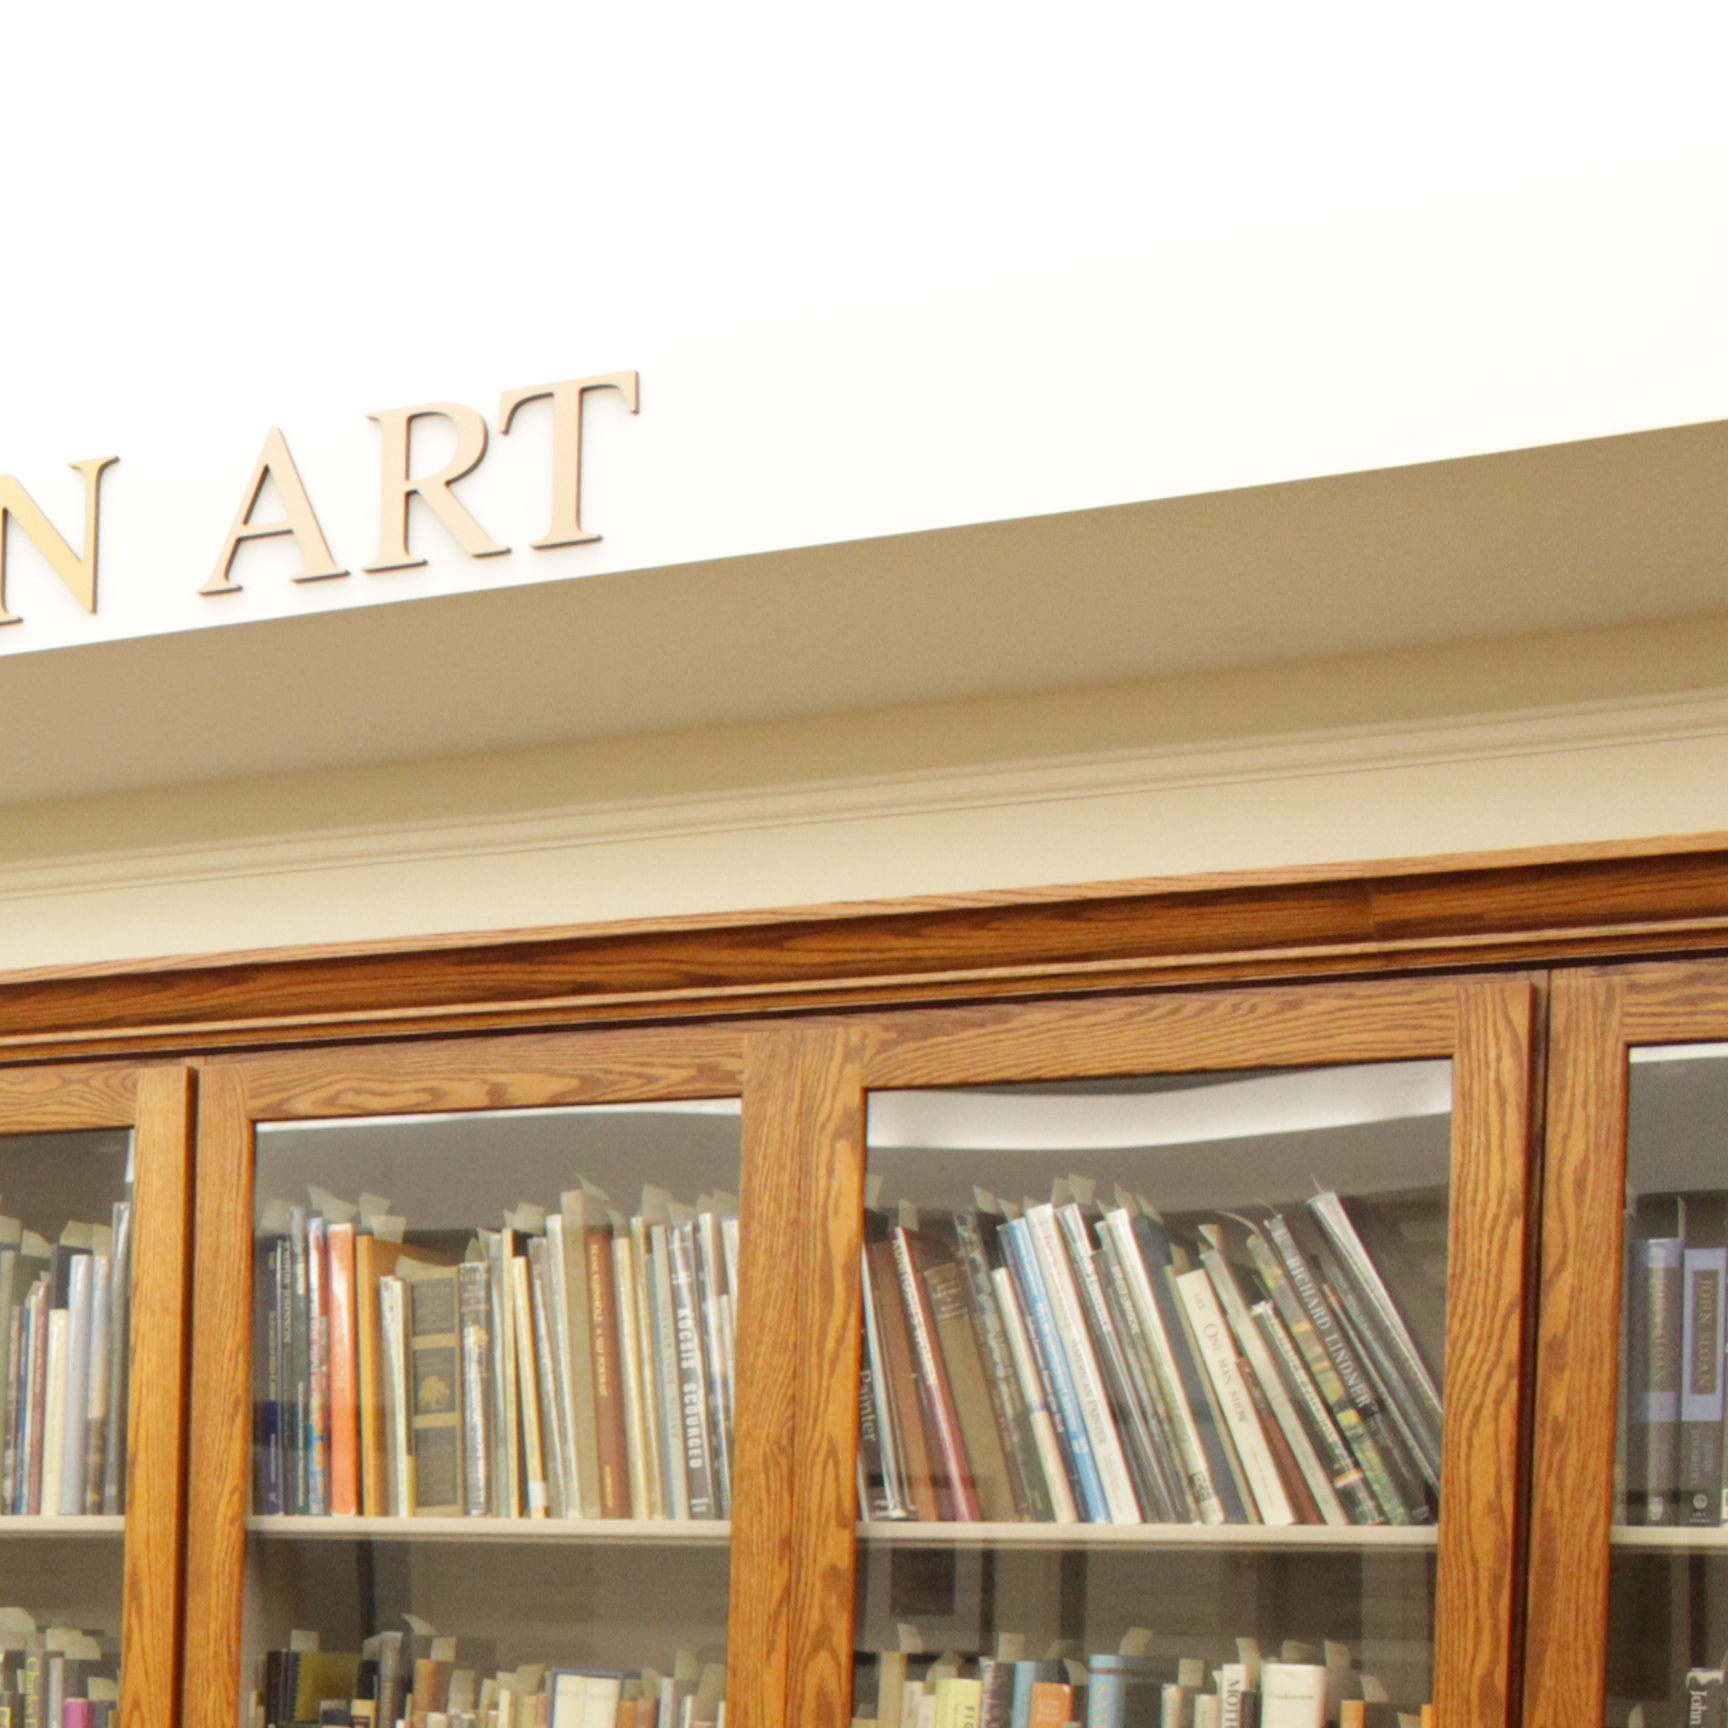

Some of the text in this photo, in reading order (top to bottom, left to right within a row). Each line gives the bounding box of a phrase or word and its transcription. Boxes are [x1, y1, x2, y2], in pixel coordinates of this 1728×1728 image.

[196, 370, 641, 602] ART
[281, 1288, 292, 1343] JOHNSON
[914, 1330, 936, 1386] WOMEN
[1285, 1257, 1371, 1409] RICHARD LINDNER
[1697, 1280, 1713, 1386] JOHN SLOAN
[677, 1308, 703, 1468] KOCSIS SCOURGED
[860, 1369, 877, 1441] Painter
[1070, 1339, 1107, 1445] AMERICAN PAINTER
[24, 1657, 39, 1715] Charles
[1688, 1691, 1707, 1725] John
